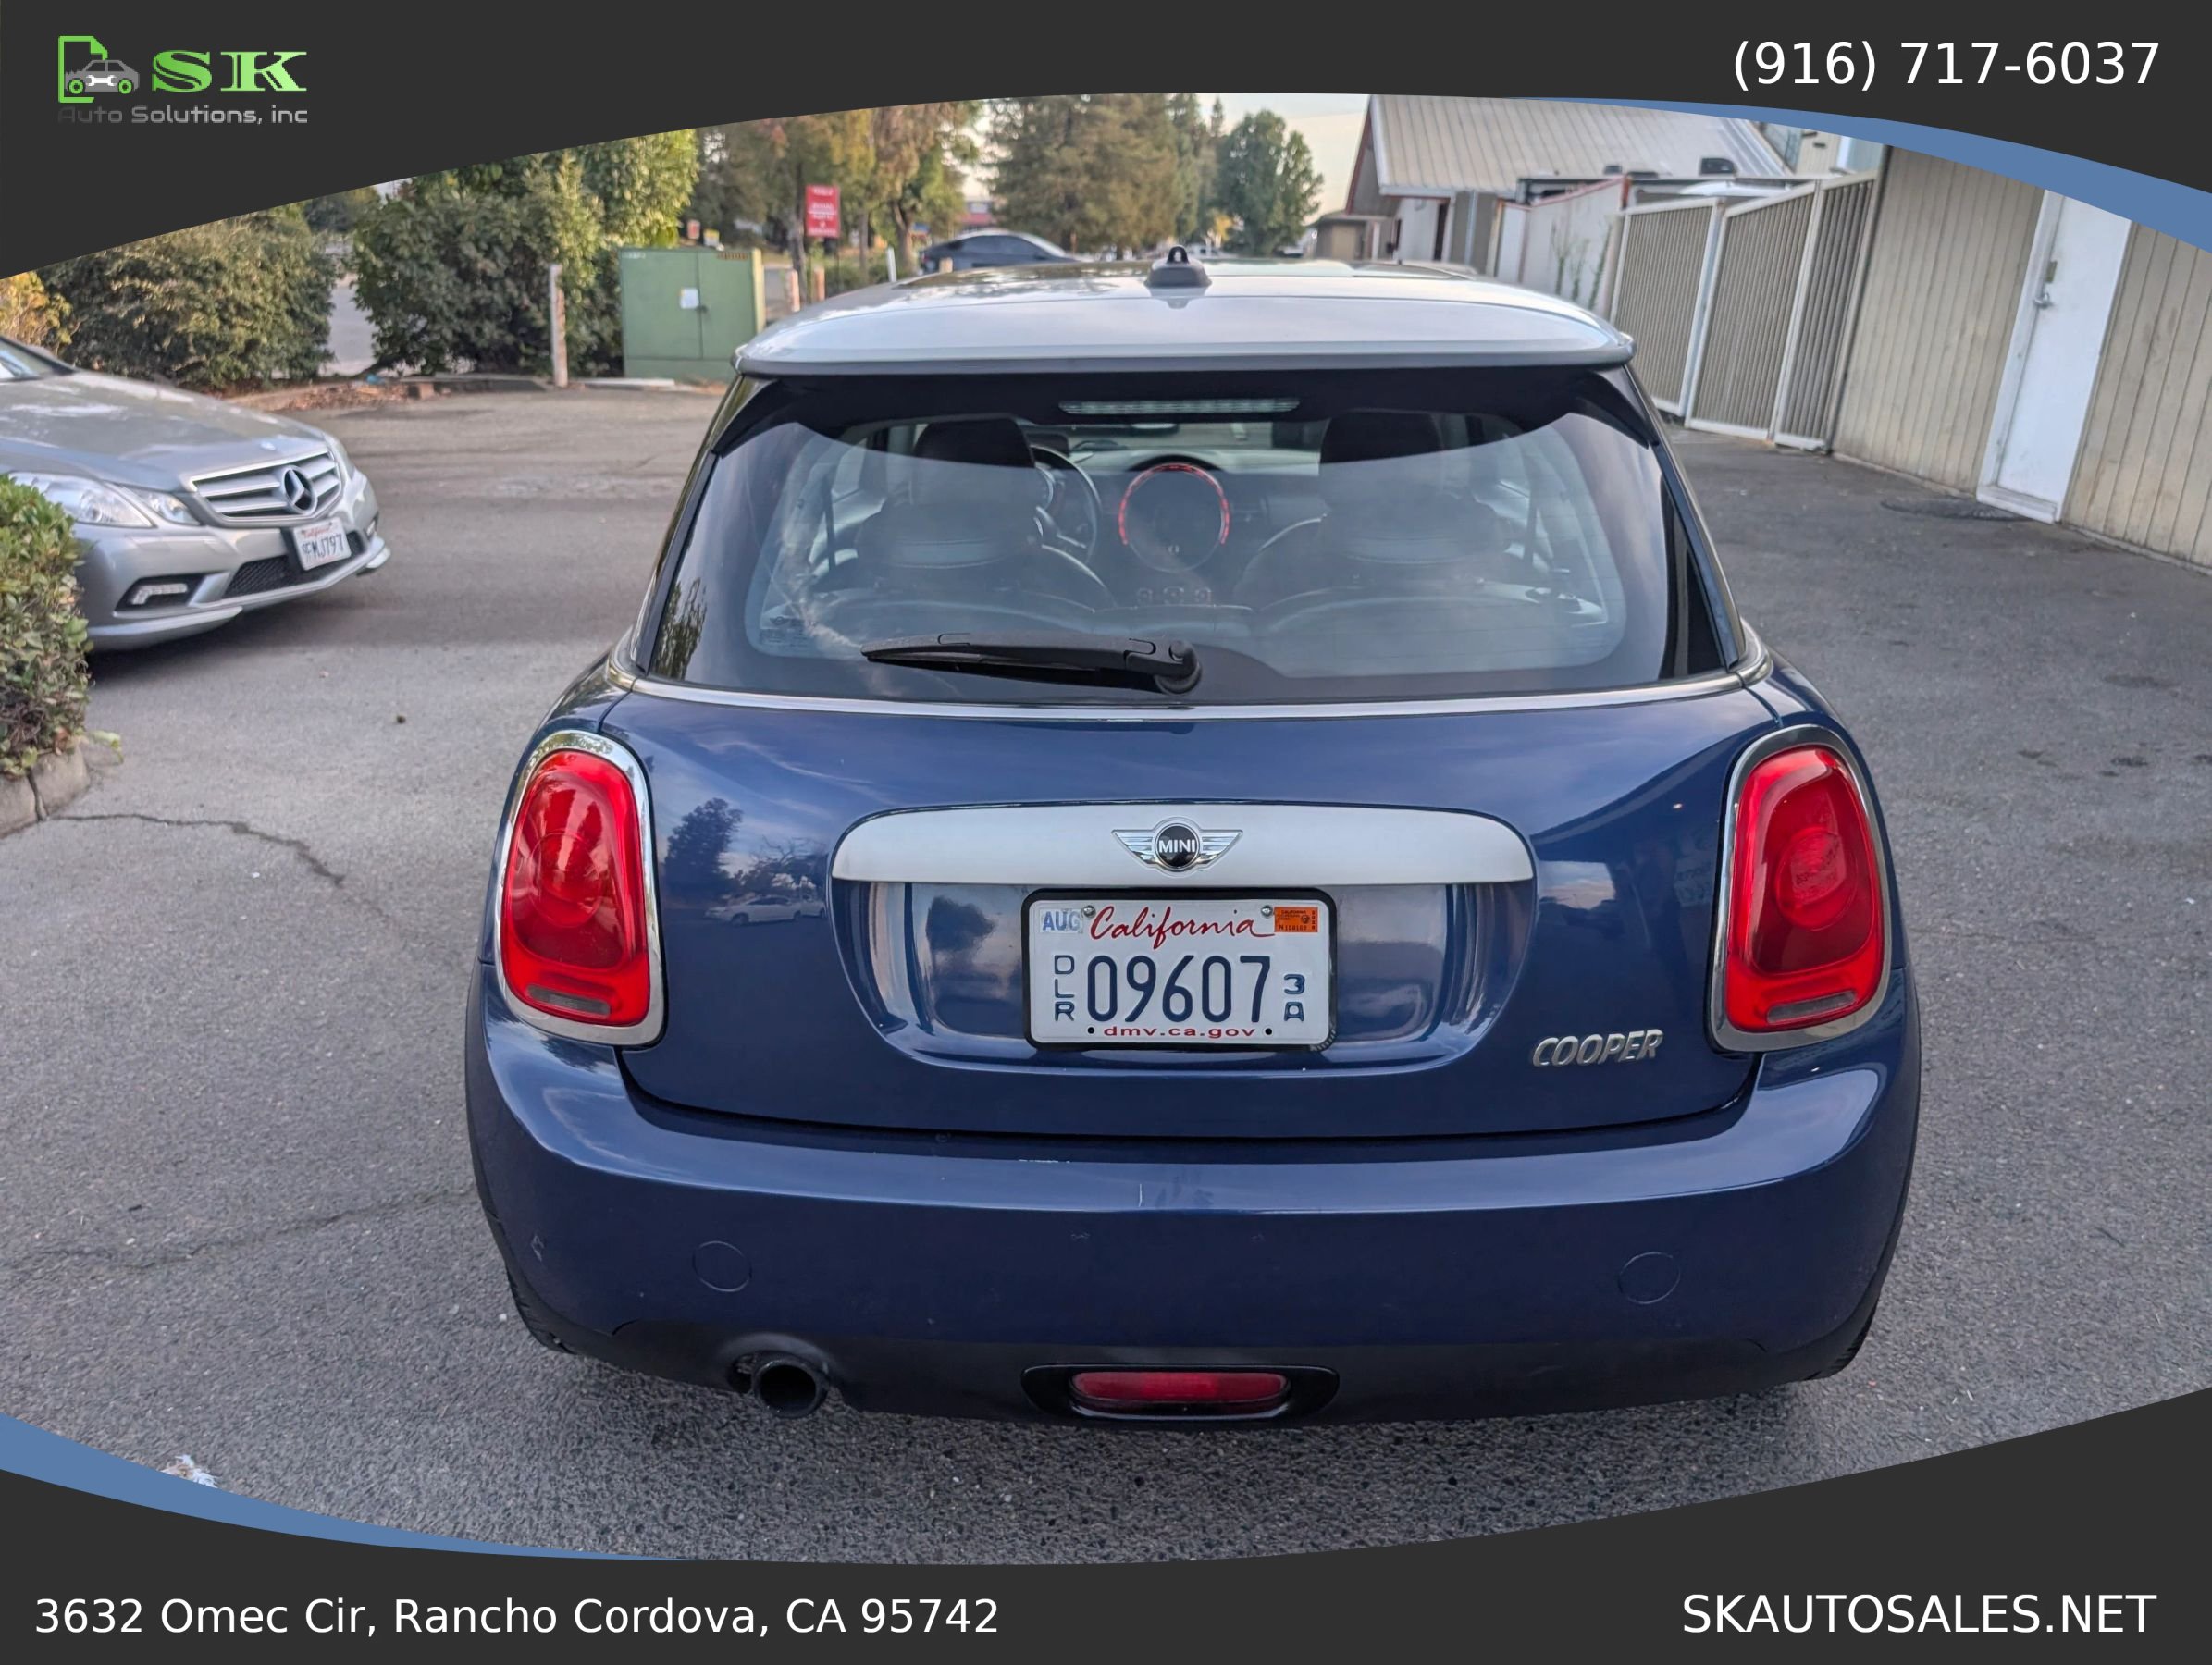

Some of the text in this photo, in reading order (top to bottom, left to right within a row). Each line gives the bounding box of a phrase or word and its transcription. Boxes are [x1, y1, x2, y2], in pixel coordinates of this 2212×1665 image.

[1159, 839, 1196, 853] MINI
[1043, 910, 1081, 931] AUG
[1090, 906, 1275, 950] California
[1054, 955, 1075, 1021] DLR
[1087, 955, 1271, 1023] 09607
[1104, 1026, 1256, 1038] dmv.ca.gov
[1532, 1029, 1663, 1067] COOPER
